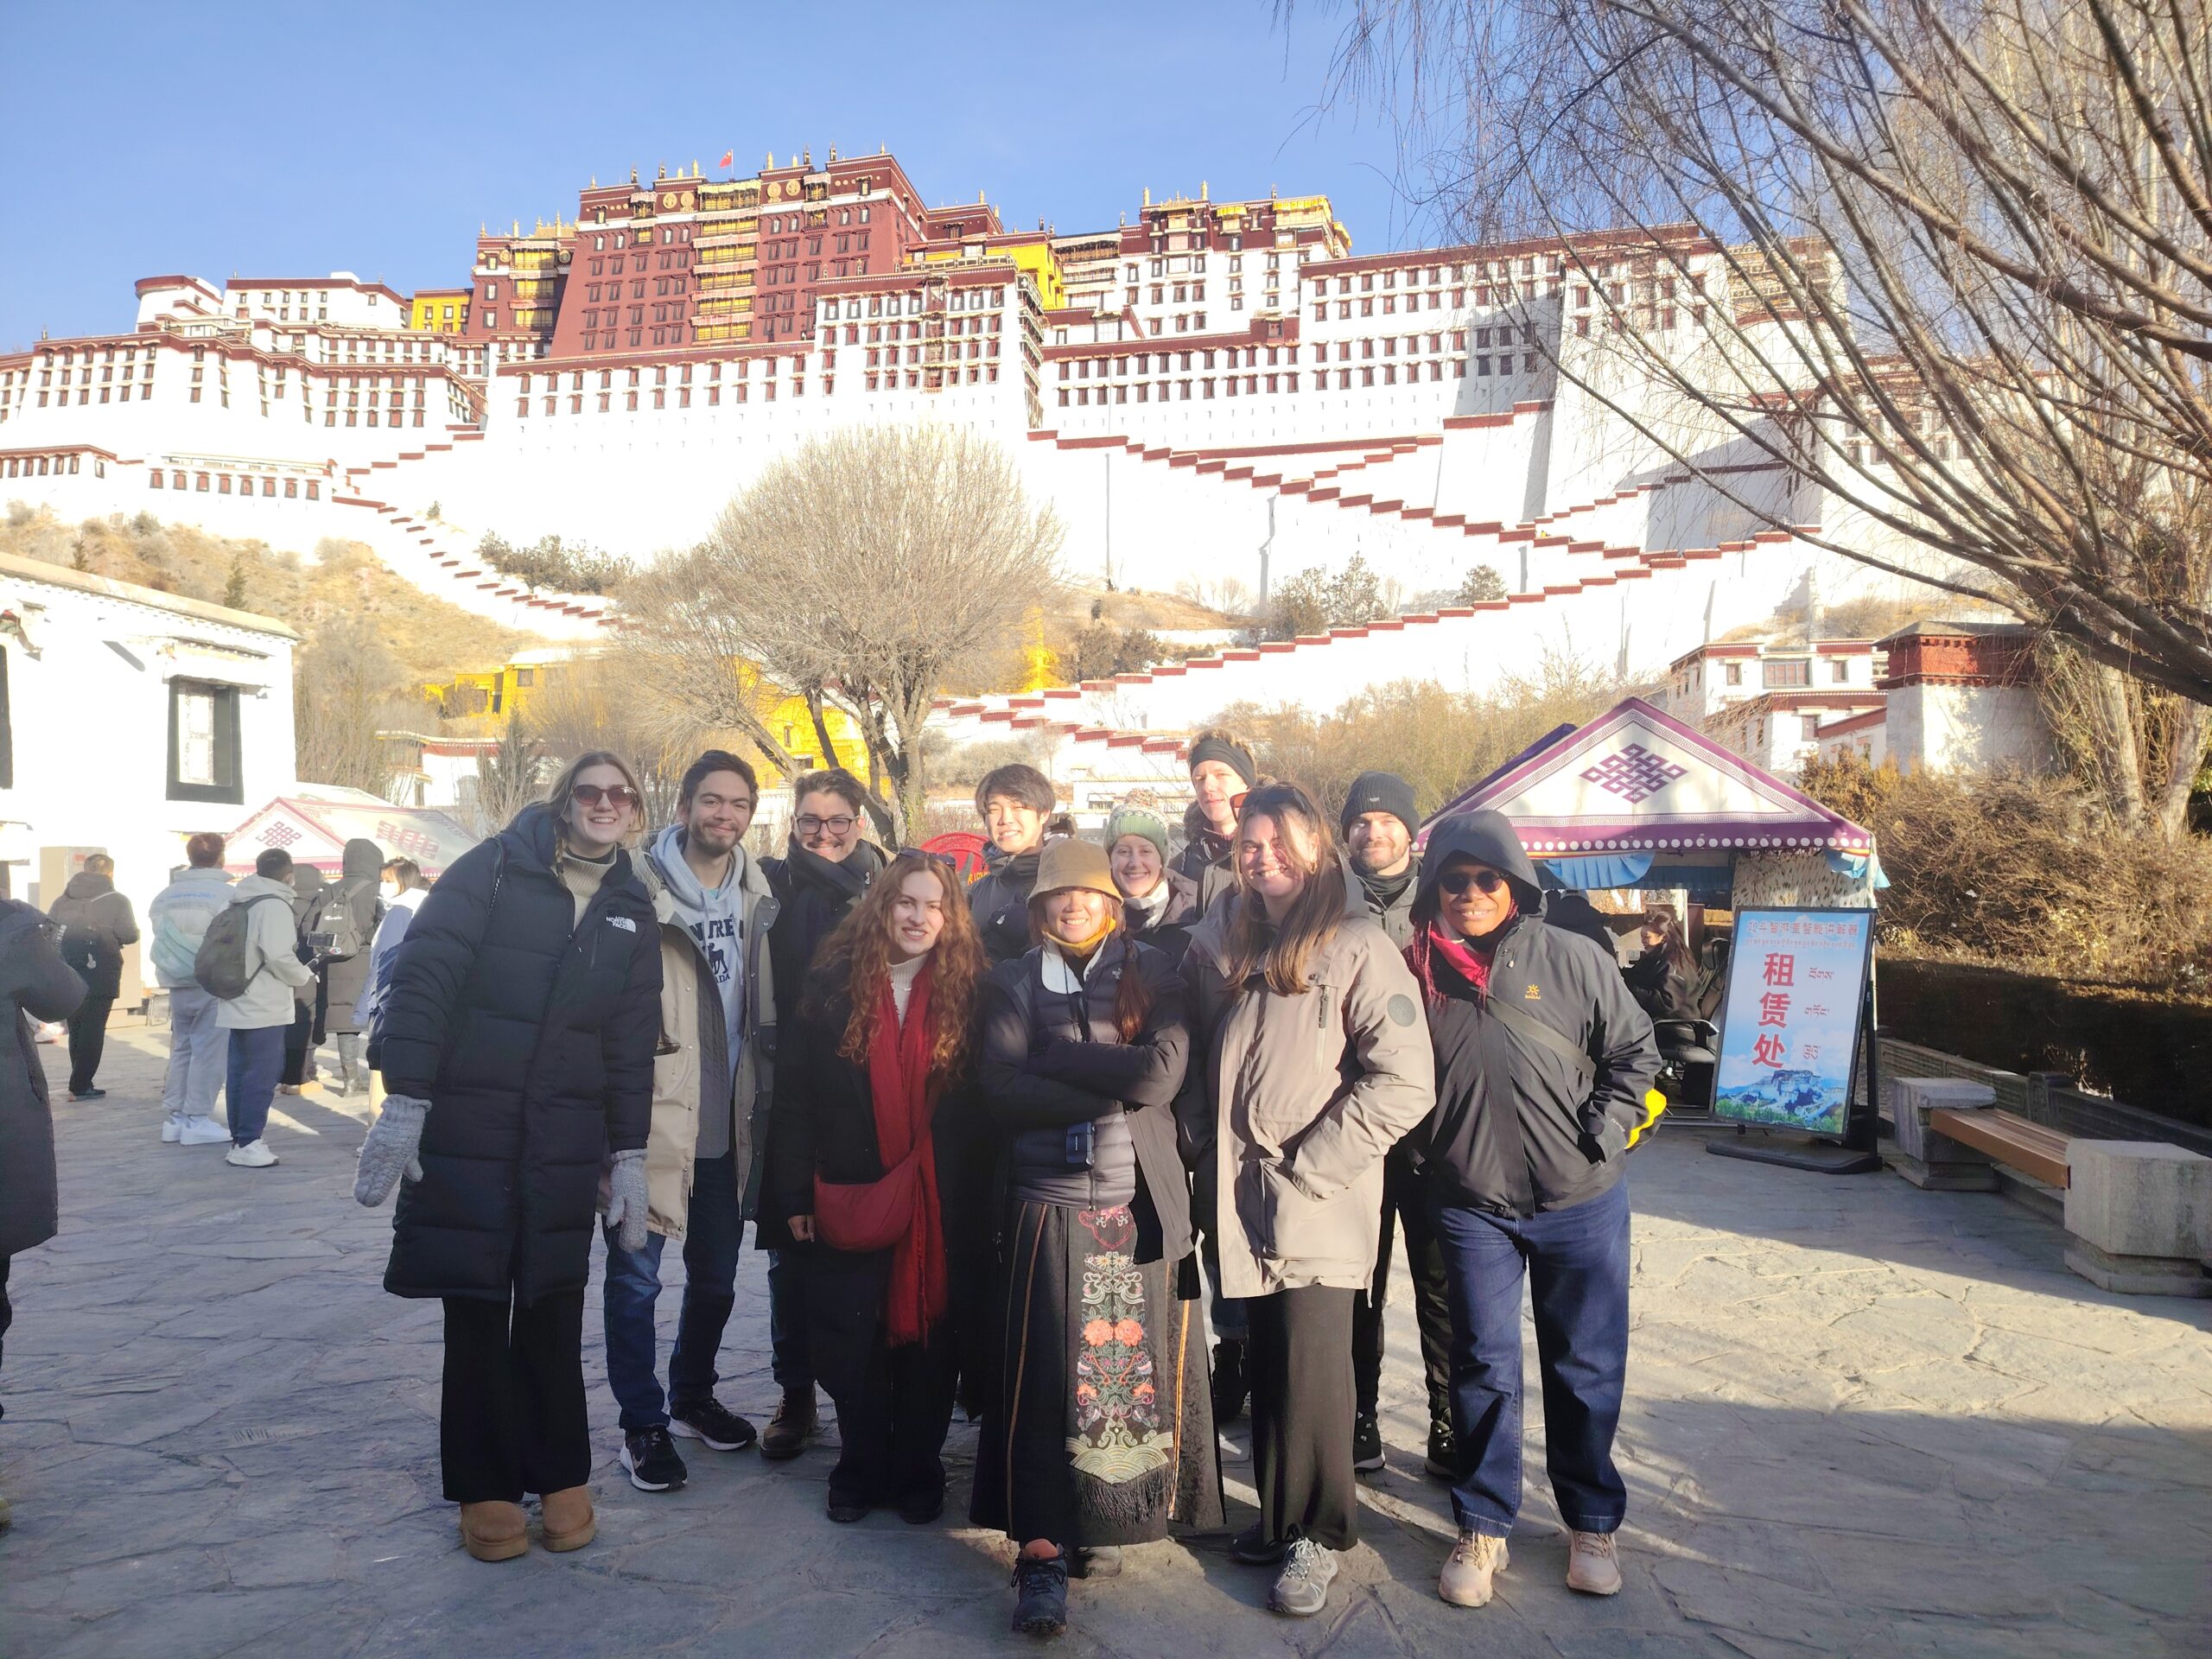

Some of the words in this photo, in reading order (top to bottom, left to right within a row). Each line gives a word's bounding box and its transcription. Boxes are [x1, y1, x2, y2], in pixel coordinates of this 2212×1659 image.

[606, 917, 626, 925] NORTH
[1751, 952, 1795, 1069] 租赁处
